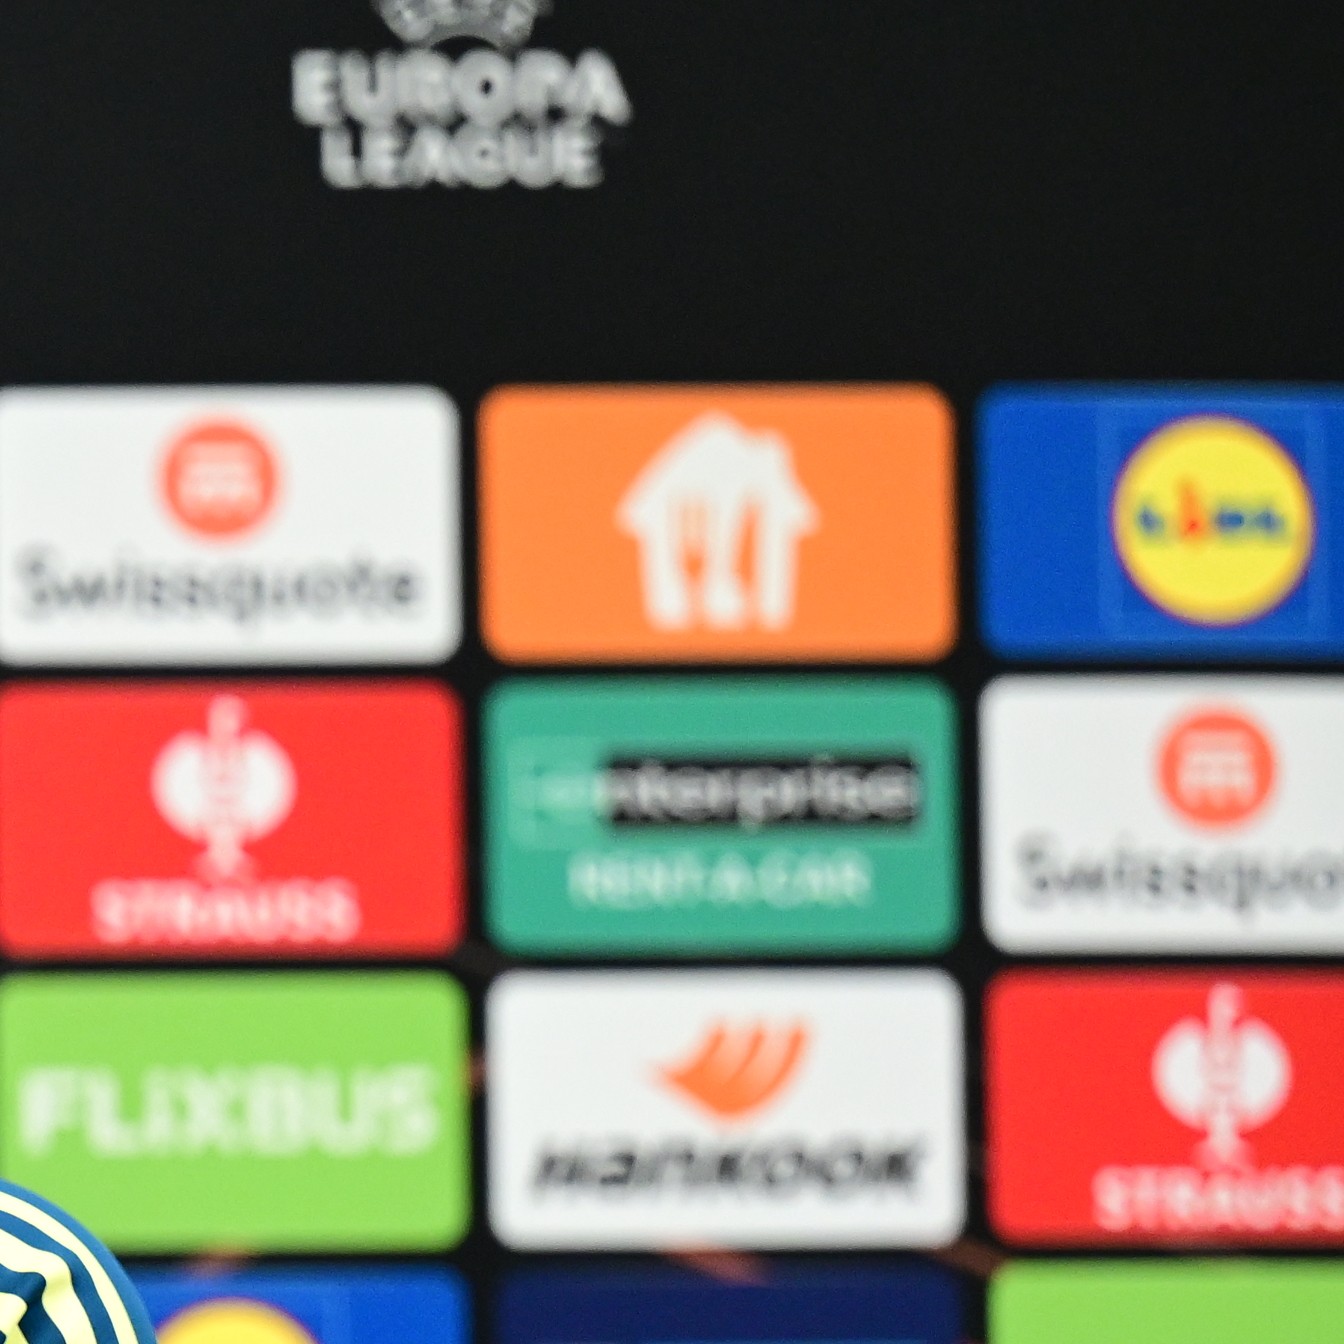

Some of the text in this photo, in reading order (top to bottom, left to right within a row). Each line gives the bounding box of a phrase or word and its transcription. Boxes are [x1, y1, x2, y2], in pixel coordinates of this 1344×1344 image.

[293, 48, 633, 126] EUROPA
[322, 122, 603, 188] LEAGUE
[14, 545, 426, 635] Swissquote
[90, 878, 364, 944] STRAUSS
